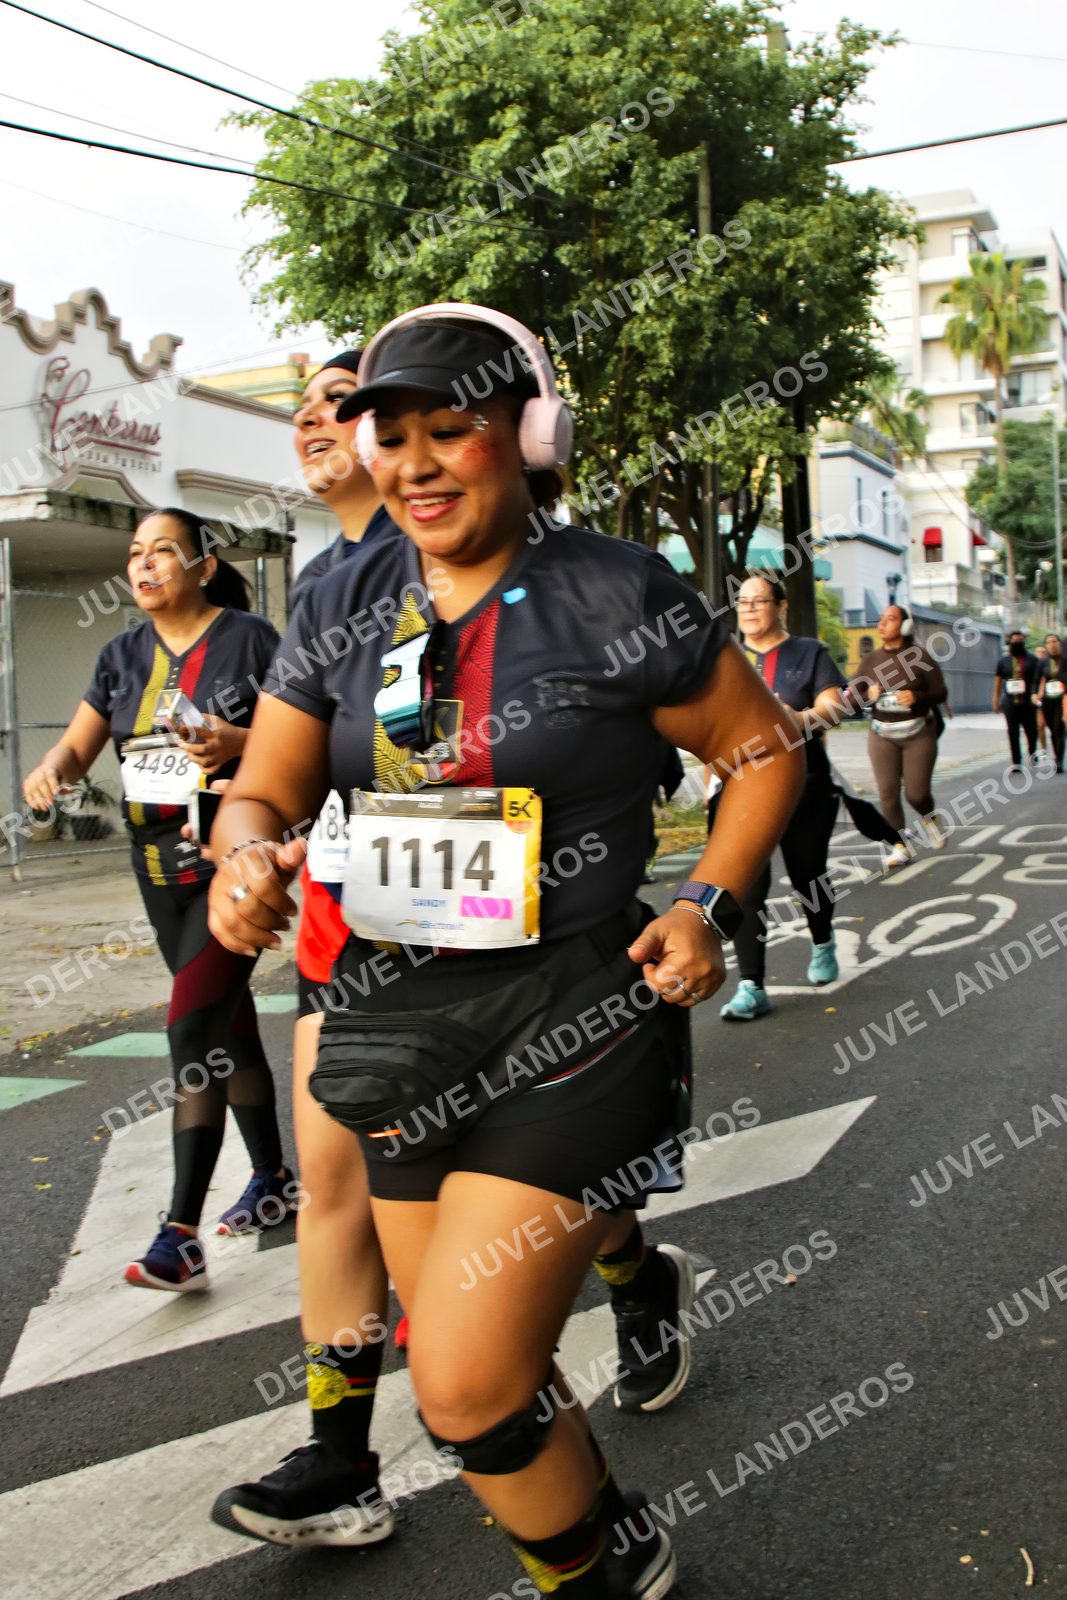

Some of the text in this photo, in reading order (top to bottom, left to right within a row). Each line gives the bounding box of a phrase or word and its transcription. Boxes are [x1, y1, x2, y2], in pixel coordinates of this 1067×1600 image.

[133, 753, 191, 776] 4498
[508, 801, 533, 818] 5K
[371, 836, 495, 891] 1114
